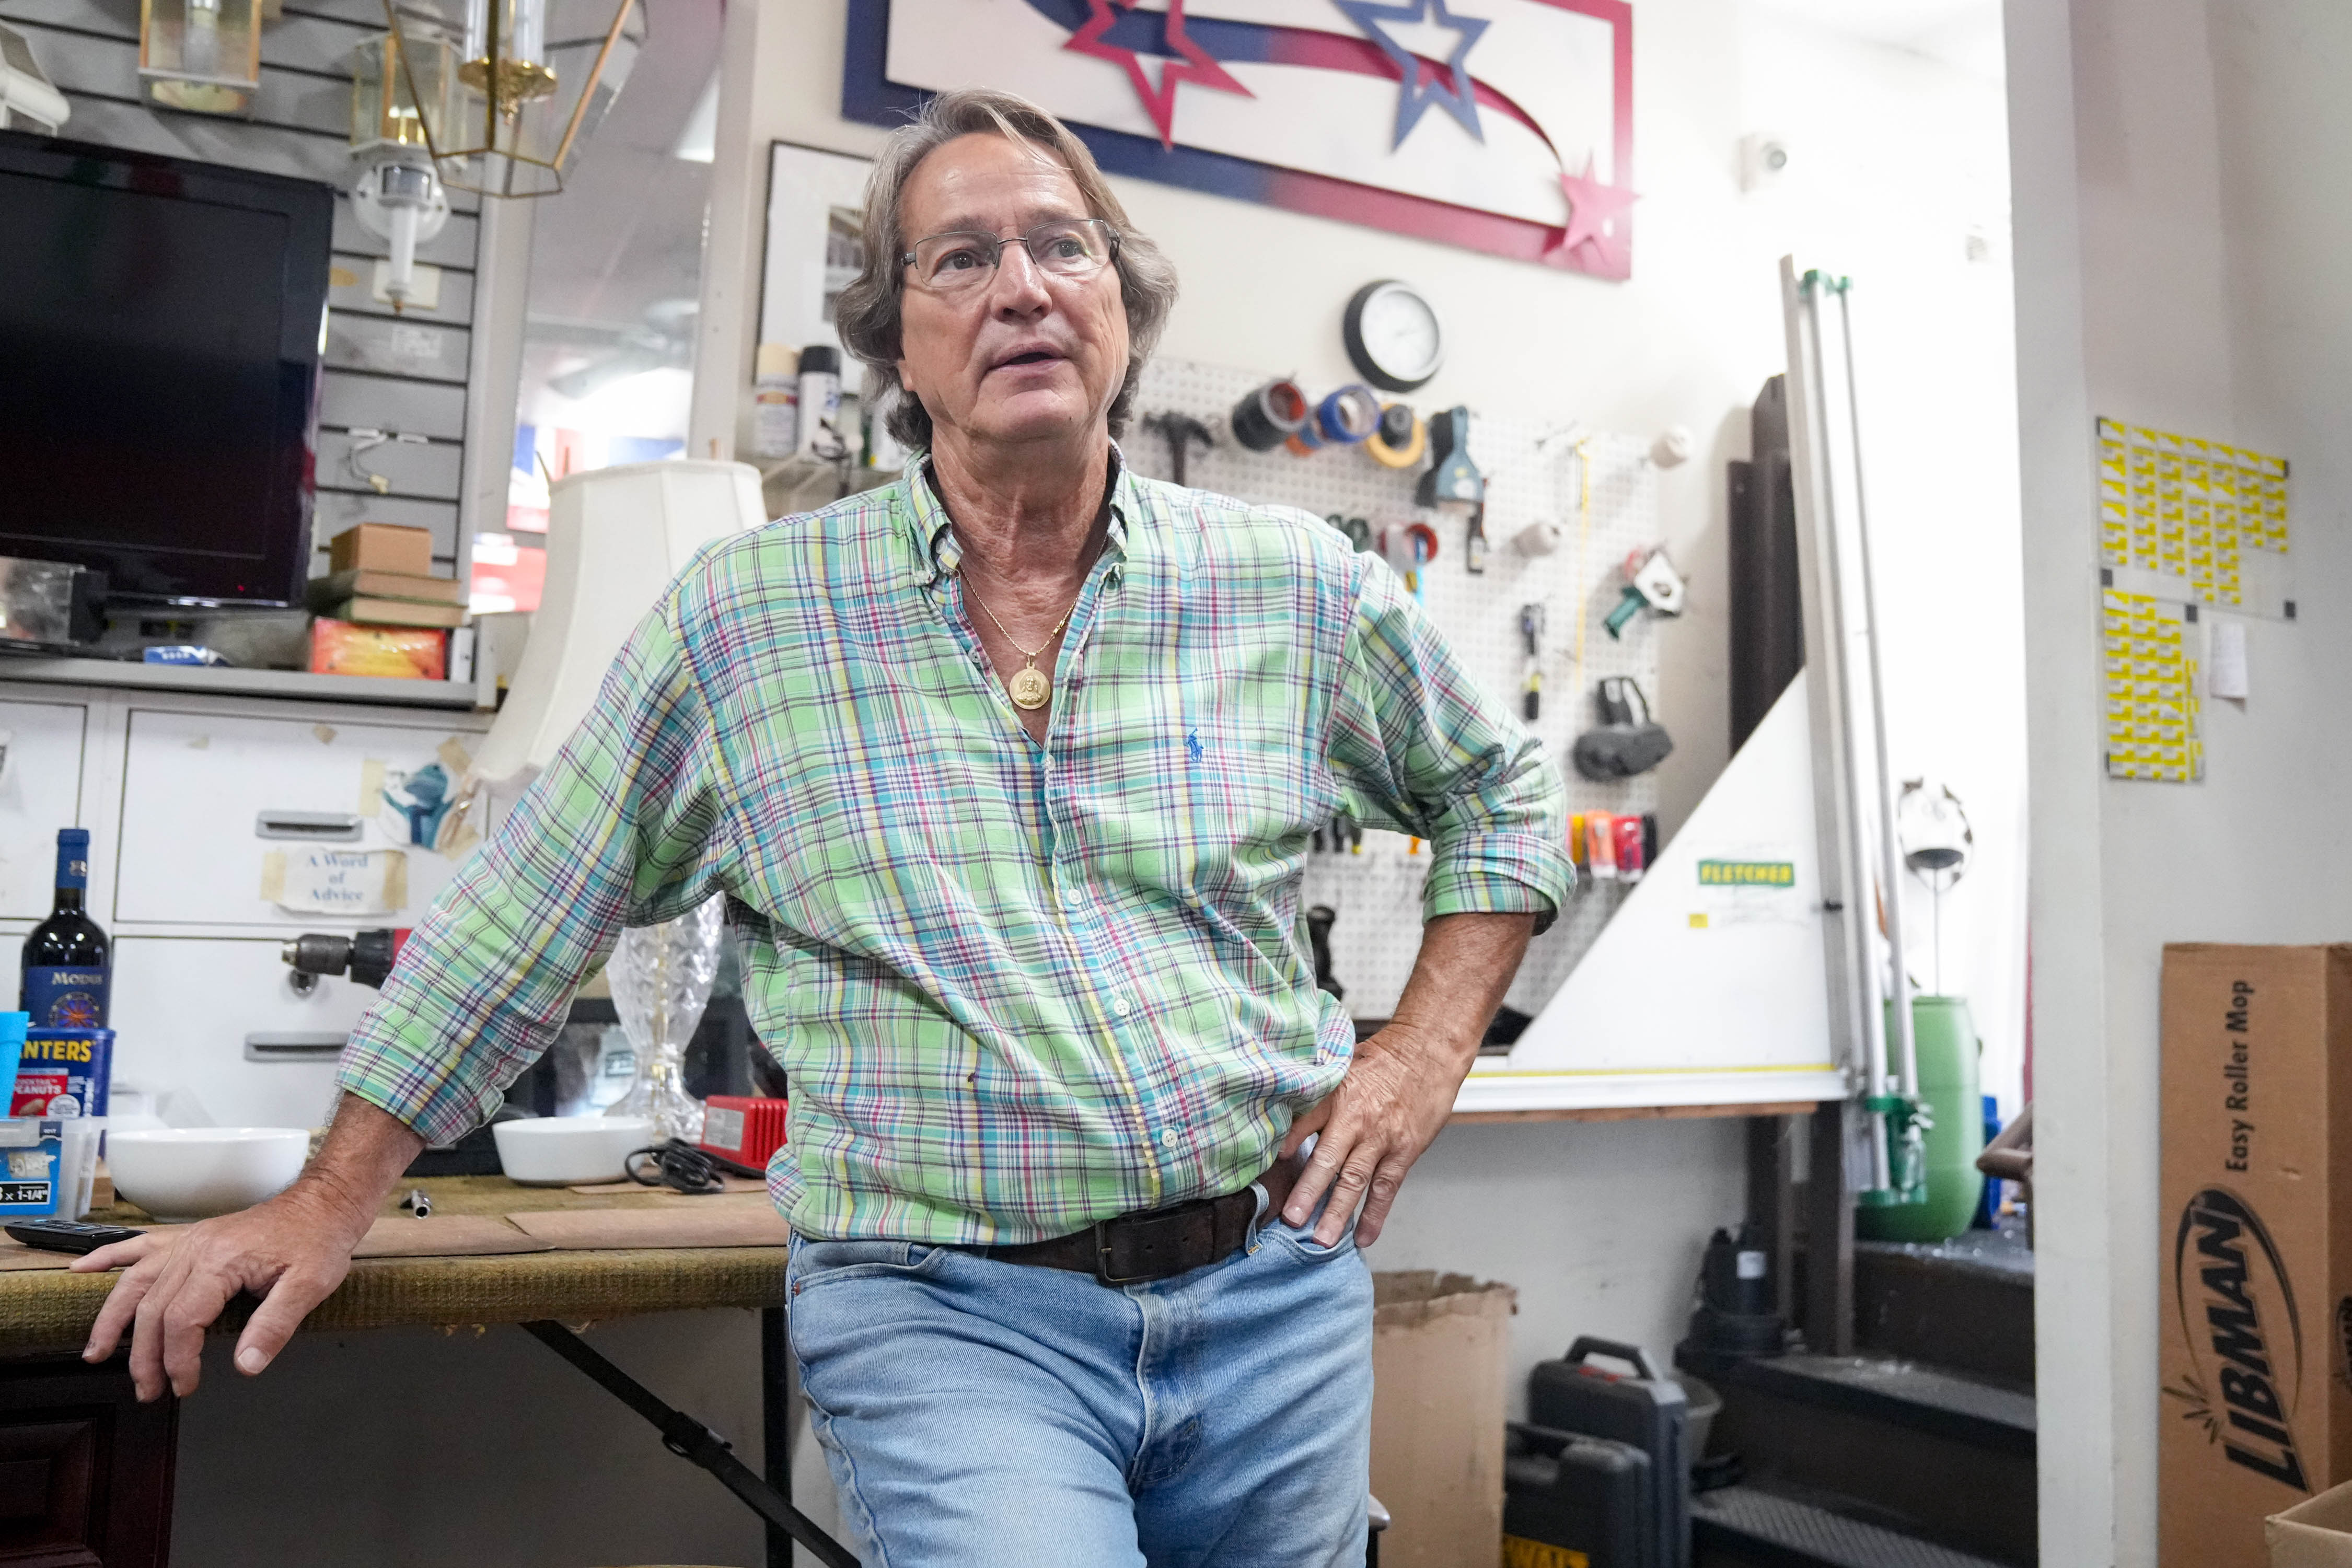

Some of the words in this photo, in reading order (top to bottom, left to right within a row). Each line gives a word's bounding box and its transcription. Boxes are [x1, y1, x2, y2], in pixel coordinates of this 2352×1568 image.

[306, 854, 318, 867] A
[325, 853, 368, 868] Word
[328, 870, 345, 884] of
[310, 888, 364, 901] Advice
[2225, 980, 2256, 1033] Mop
[21, 1039, 92, 1062] NTERS
[2224, 1041, 2249, 1111] Roller
[2225, 1118, 2256, 1172] Easy
[2191, 1204, 2309, 1492] LIBMAN
